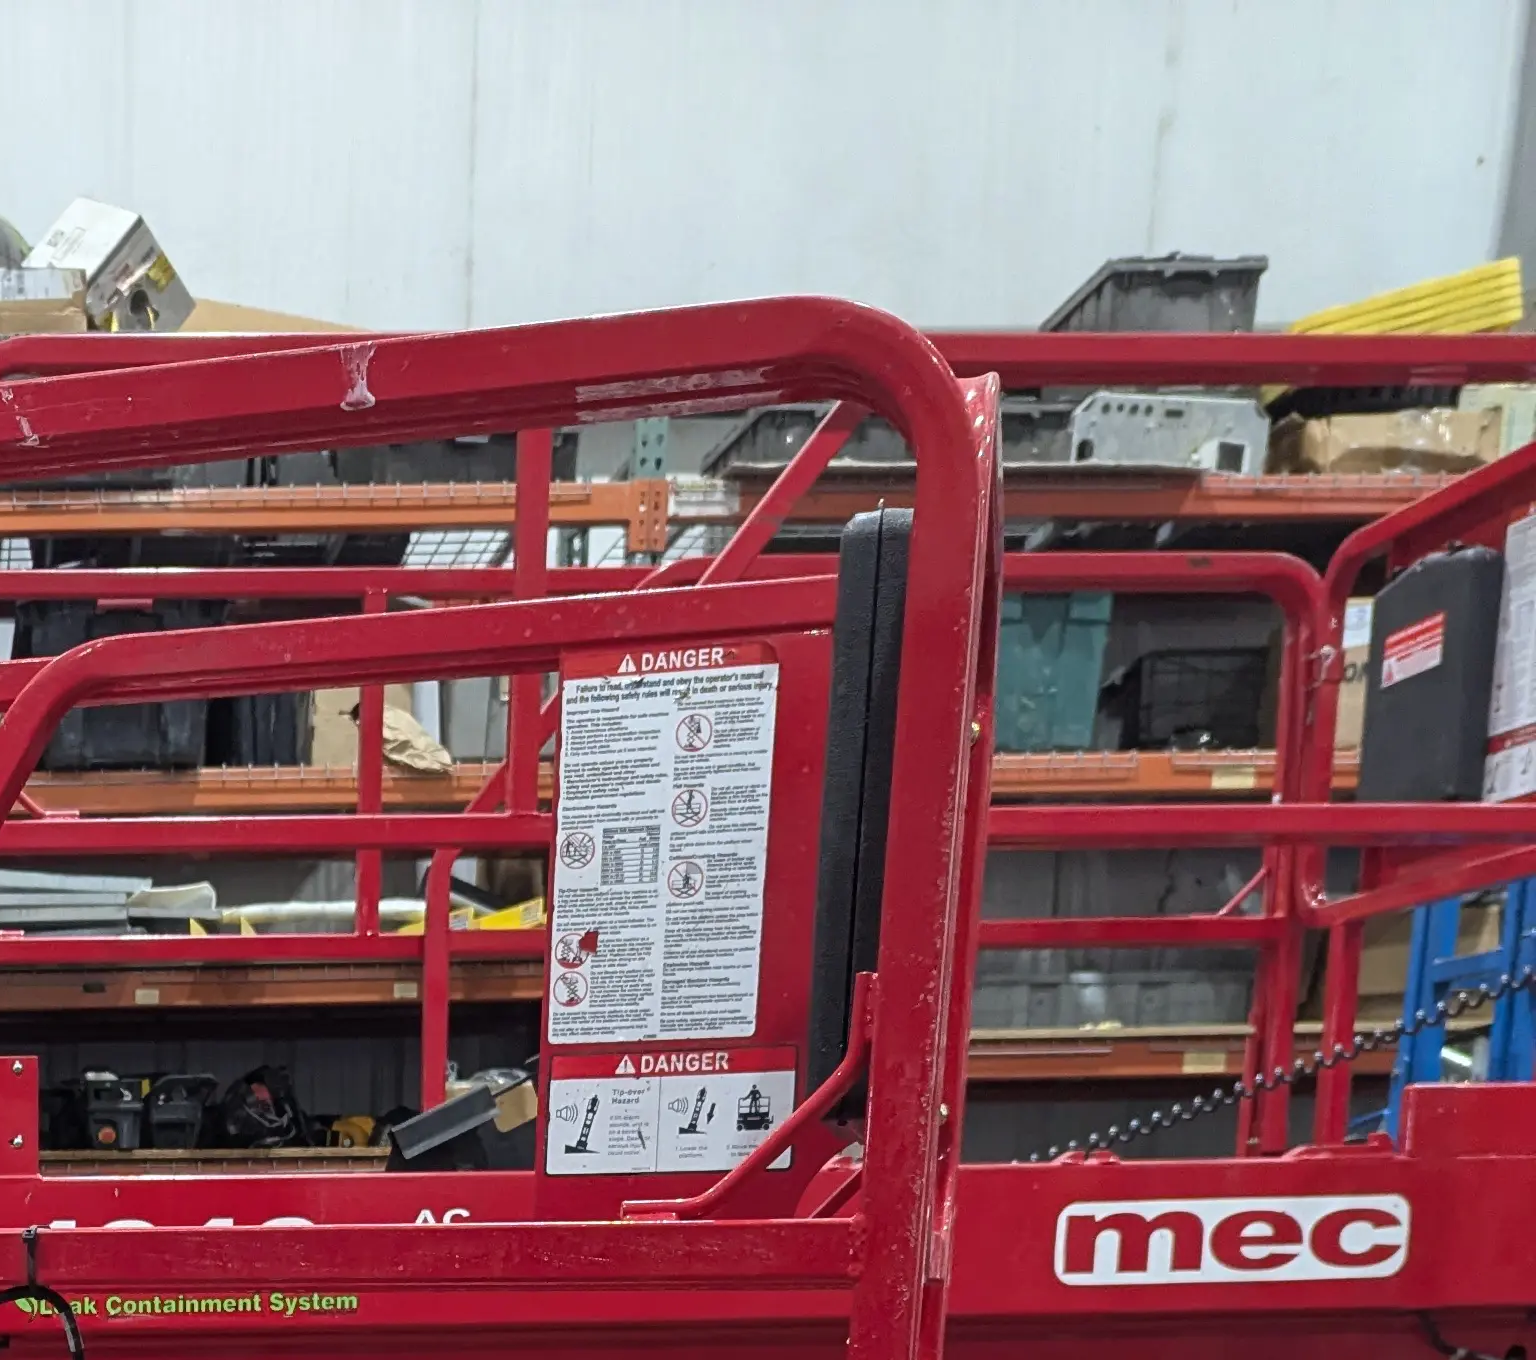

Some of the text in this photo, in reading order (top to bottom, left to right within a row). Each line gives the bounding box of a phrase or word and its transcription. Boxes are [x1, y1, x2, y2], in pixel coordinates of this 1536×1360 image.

[641, 647, 724, 671] DANGER
[576, 684, 597, 693] Failure
[599, 683, 605, 691] to
[663, 678, 674, 686] and
[676, 677, 692, 687] obey
[694, 676, 704, 684] the
[705, 673, 738, 683] operator's
[740, 670, 764, 679] manual
[566, 696, 578, 705] and
[579, 695, 589, 703] the
[590, 693, 619, 703] following
[621, 692, 640, 701] safety
[642, 690, 658, 698] rules
[659, 689, 670, 697] will
[700, 685, 718, 694] death
[728, 683, 752, 692] serious
[640, 1052, 729, 1073] DANGER
[612, 1096, 640, 1105] Hazard
[1063, 1208, 1404, 1275] mec
[40, 1291, 359, 1318] Lak Containment System
